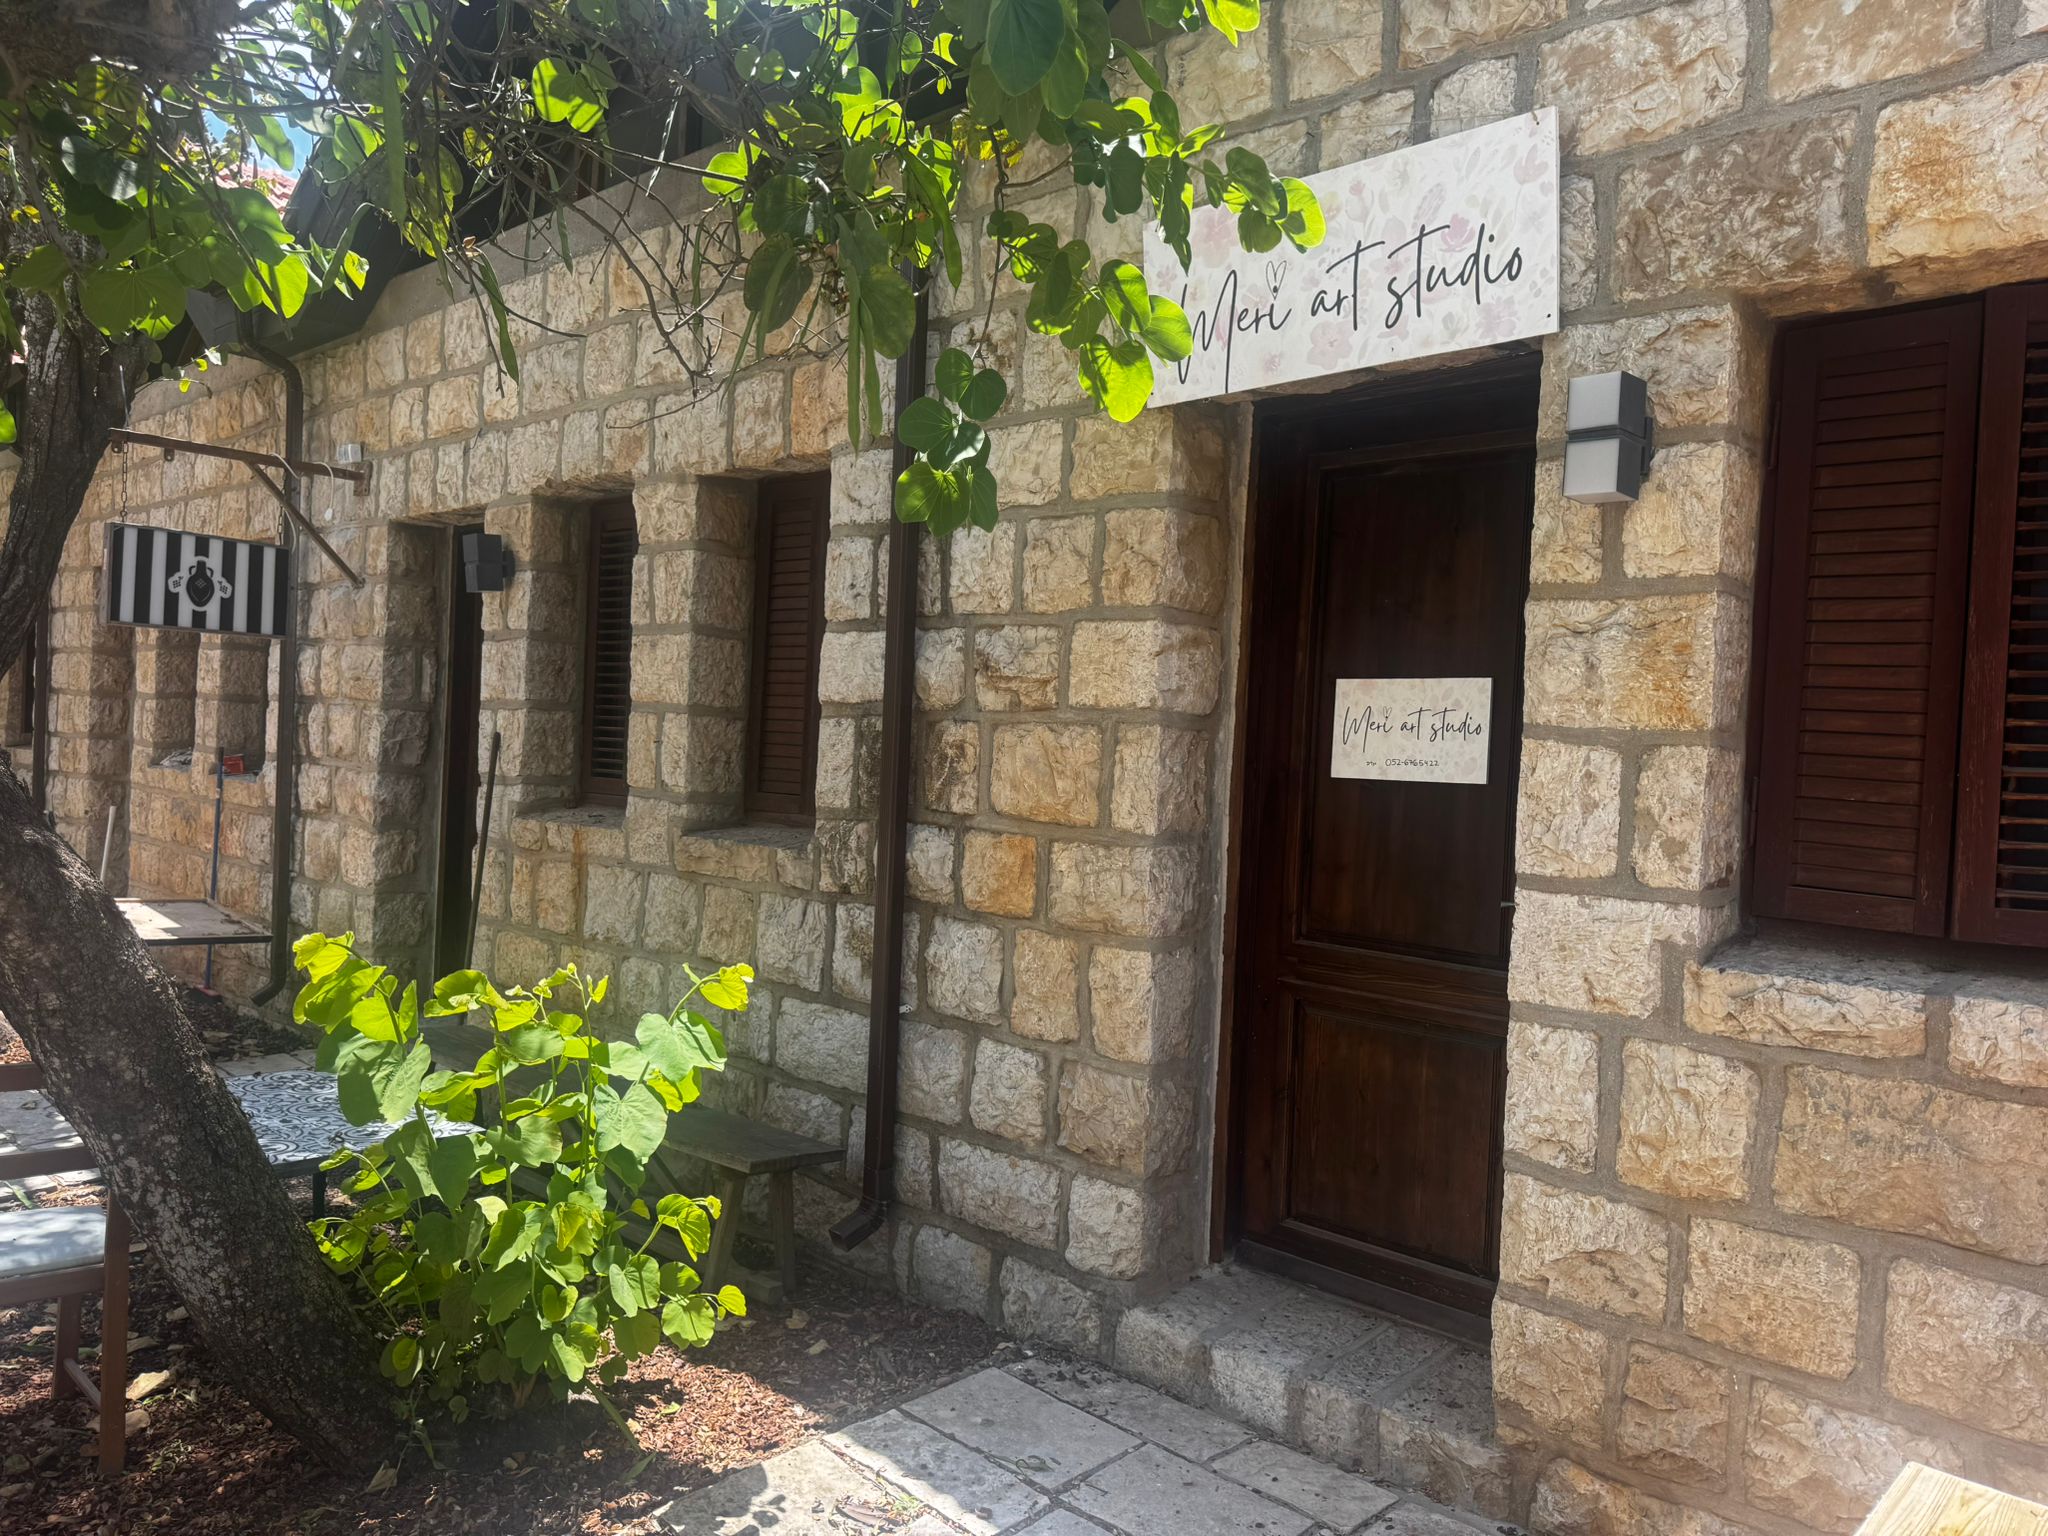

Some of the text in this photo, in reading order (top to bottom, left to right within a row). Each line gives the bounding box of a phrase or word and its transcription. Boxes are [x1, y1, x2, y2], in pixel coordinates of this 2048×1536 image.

[1177, 222, 1523, 394] Meri art studio
[1342, 705, 1482, 753] Meri art studio
